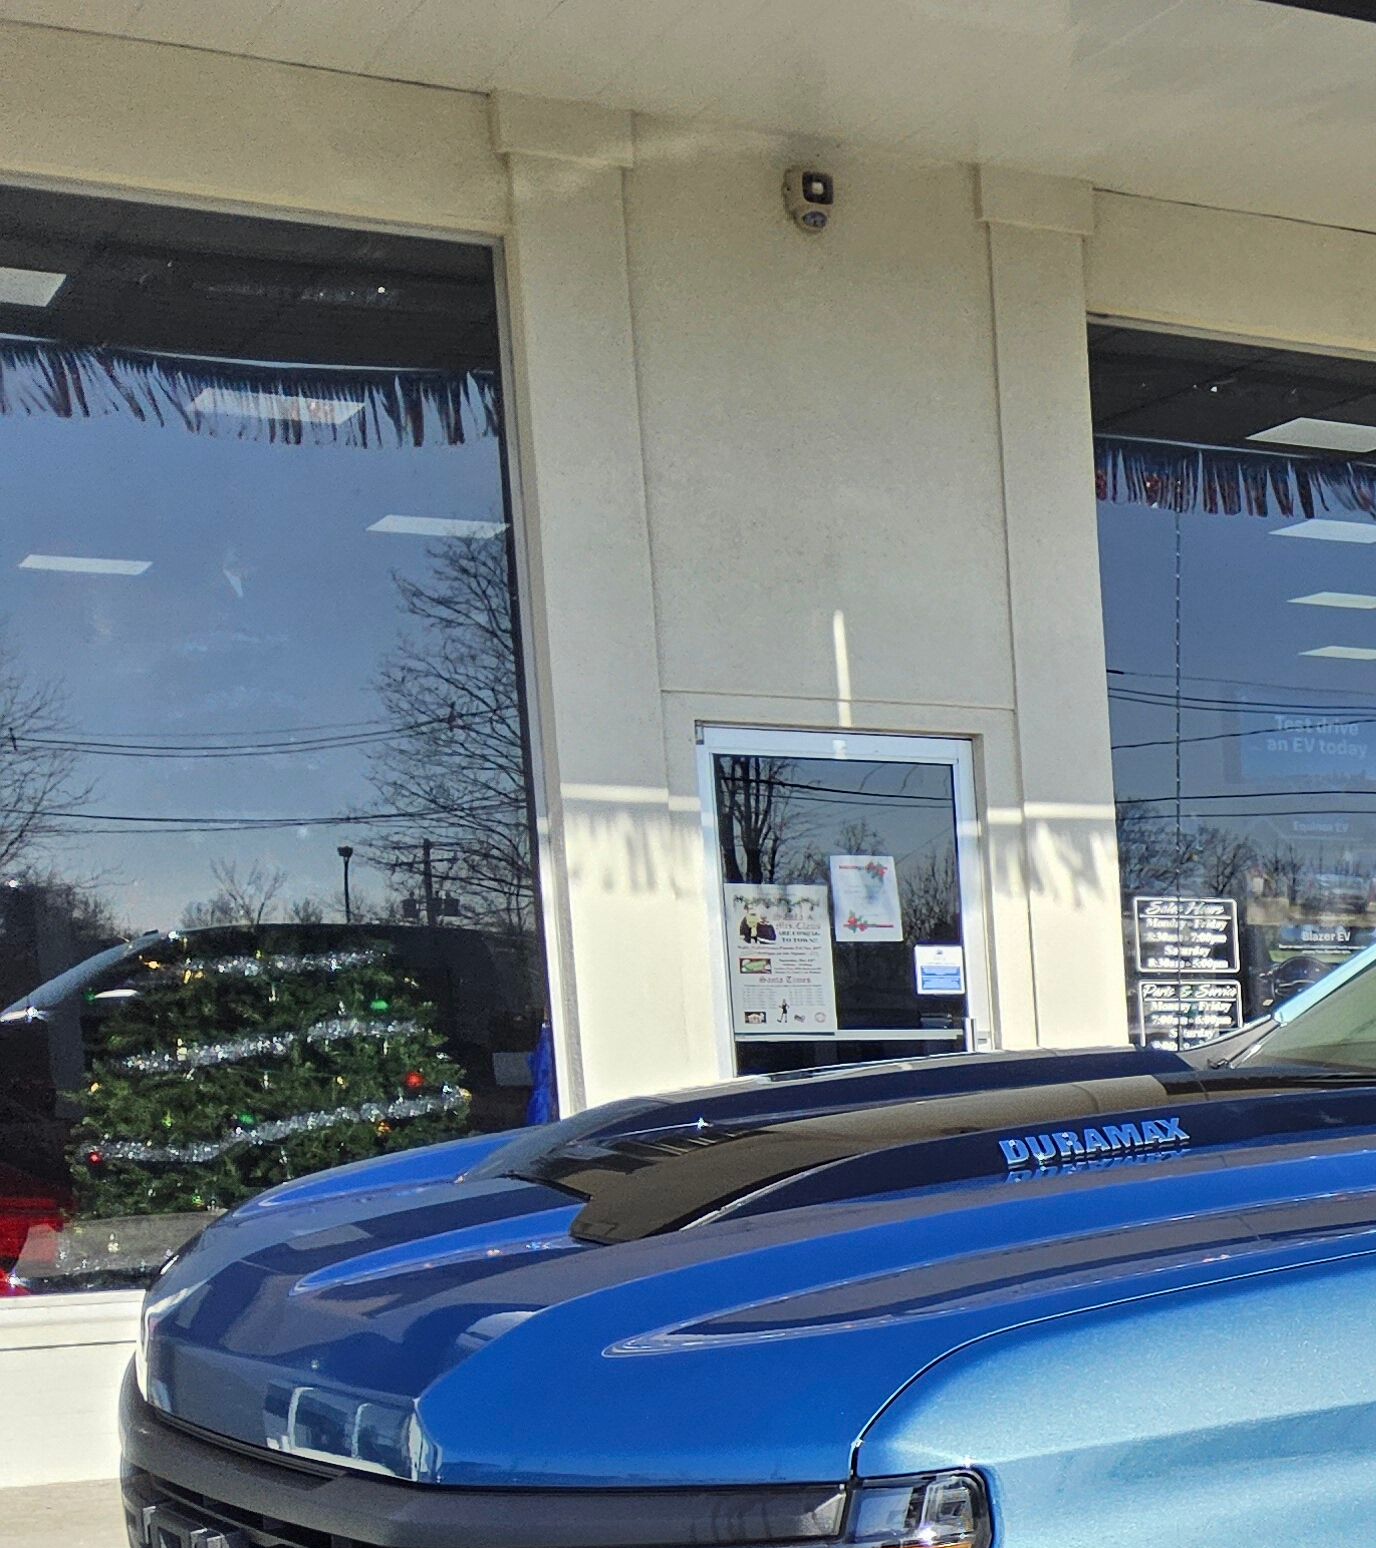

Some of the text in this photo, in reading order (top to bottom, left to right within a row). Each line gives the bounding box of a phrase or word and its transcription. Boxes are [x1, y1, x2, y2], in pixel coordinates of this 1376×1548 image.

[1273, 714, 1360, 736] Test drive
[1266, 738, 1368, 760] an EV today
[1193, 918, 1229, 932] Friday
[1301, 930, 1351, 942] Blazer EV
[1142, 984, 1237, 998] Parts & Service
[1150, 1001, 1192, 1013] Monday
[1198, 1001, 1232, 1013] Friday
[1168, 1028, 1216, 1040] Sturday
[999, 1117, 1190, 1165] DURAMAX
